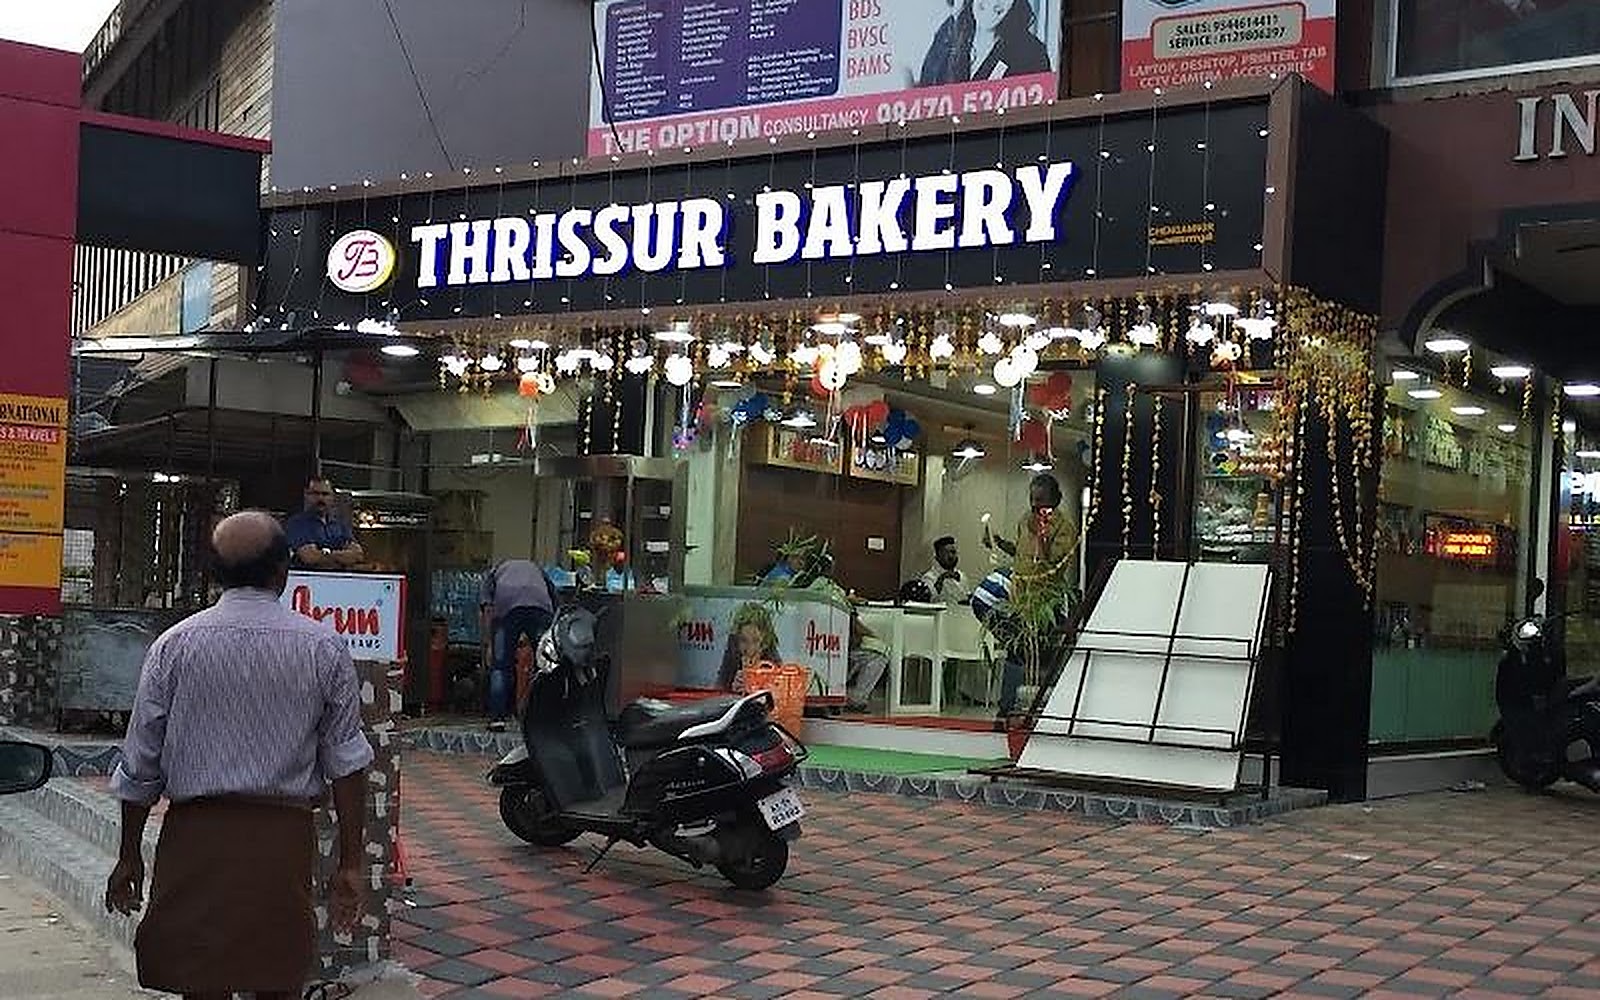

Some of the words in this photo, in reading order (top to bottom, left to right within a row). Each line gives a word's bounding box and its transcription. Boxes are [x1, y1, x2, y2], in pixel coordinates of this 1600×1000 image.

[848, 23, 889, 49] BVSC
[847, 53, 892, 79] BAMS
[602, 127, 650, 156] THE
[657, 114, 762, 150] OPTION
[763, 108, 869, 137] CONSULTANCY
[411, 198, 725, 288] THRISSUR
[753, 161, 1074, 263] BAKERY
[292, 585, 380, 635] Arun
[806, 619, 841, 658] Arun
